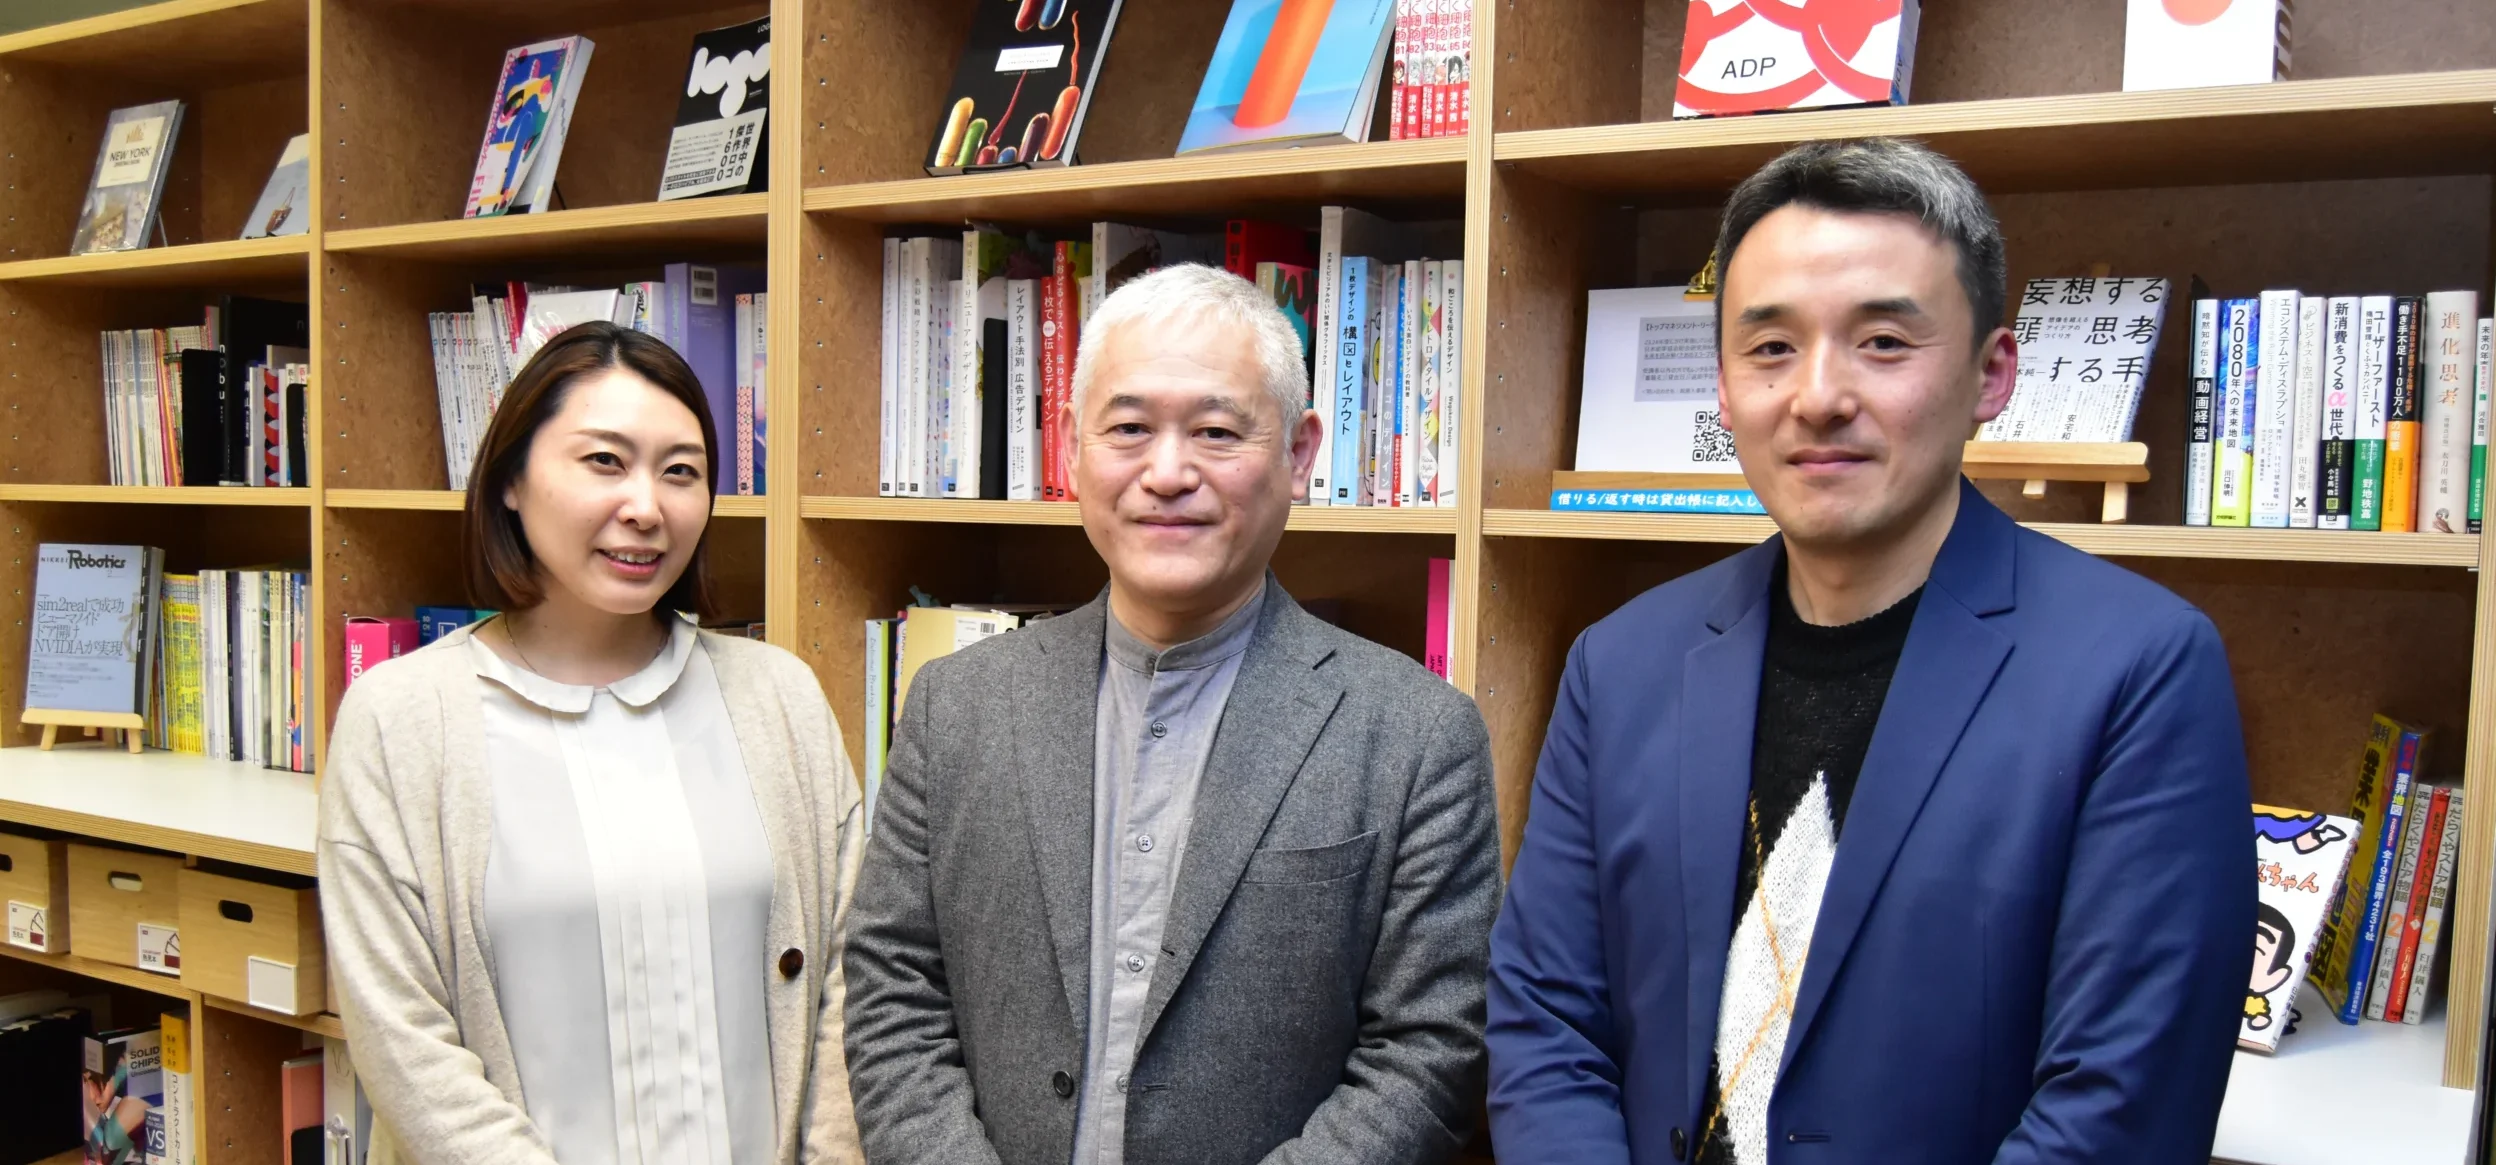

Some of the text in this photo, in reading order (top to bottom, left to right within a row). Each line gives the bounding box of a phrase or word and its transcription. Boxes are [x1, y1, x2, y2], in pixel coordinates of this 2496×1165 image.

[1721, 57, 1776, 79] ADP
[717, 128, 734, 182] 1600
[735, 122, 755, 177] 世界中の
[2022, 277, 2164, 305] 妄想する
[1446, 288, 1455, 374] 和ごころを伝えるデザイン
[2016, 315, 2157, 345] 頭 思考
[2200, 312, 2211, 375] 暗黙知が伝わる
[2050, 356, 2145, 382] する手
[2328, 302, 2349, 436] 新消費をつくるα世代
[2370, 311, 2386, 428] ユーザーファースト
[2438, 312, 2461, 407] 進化思考
[1044, 339, 1054, 421] 伝えるデザイン
[2226, 309, 2245, 448] 2080年への未来地図
[1014, 373, 1025, 433] 広告デザイン
[2193, 380, 2210, 440] 動画経営
[2012, 420, 2026, 442] 石井
[2061, 414, 2077, 442] 安宅和
[1558, 492, 1762, 507] 借りる/返す時は貸出帳に記入し
[41, 549, 126, 569] NIKKEI Robotics
[37, 597, 125, 613] sim2realで成功
[37, 612, 100, 626] ヒューマノイド
[33, 639, 124, 656] NVIDIAが実現
[2390, 772, 2410, 816] 業界地図
[2365, 850, 2393, 941] 全193業界4231社
[2387, 913, 2405, 938] 2
[2422, 920, 2439, 944] 2
[130, 1046, 160, 1060] SOLID
[130, 1056, 161, 1070] CHIPS
[146, 1127, 165, 1150] VS
